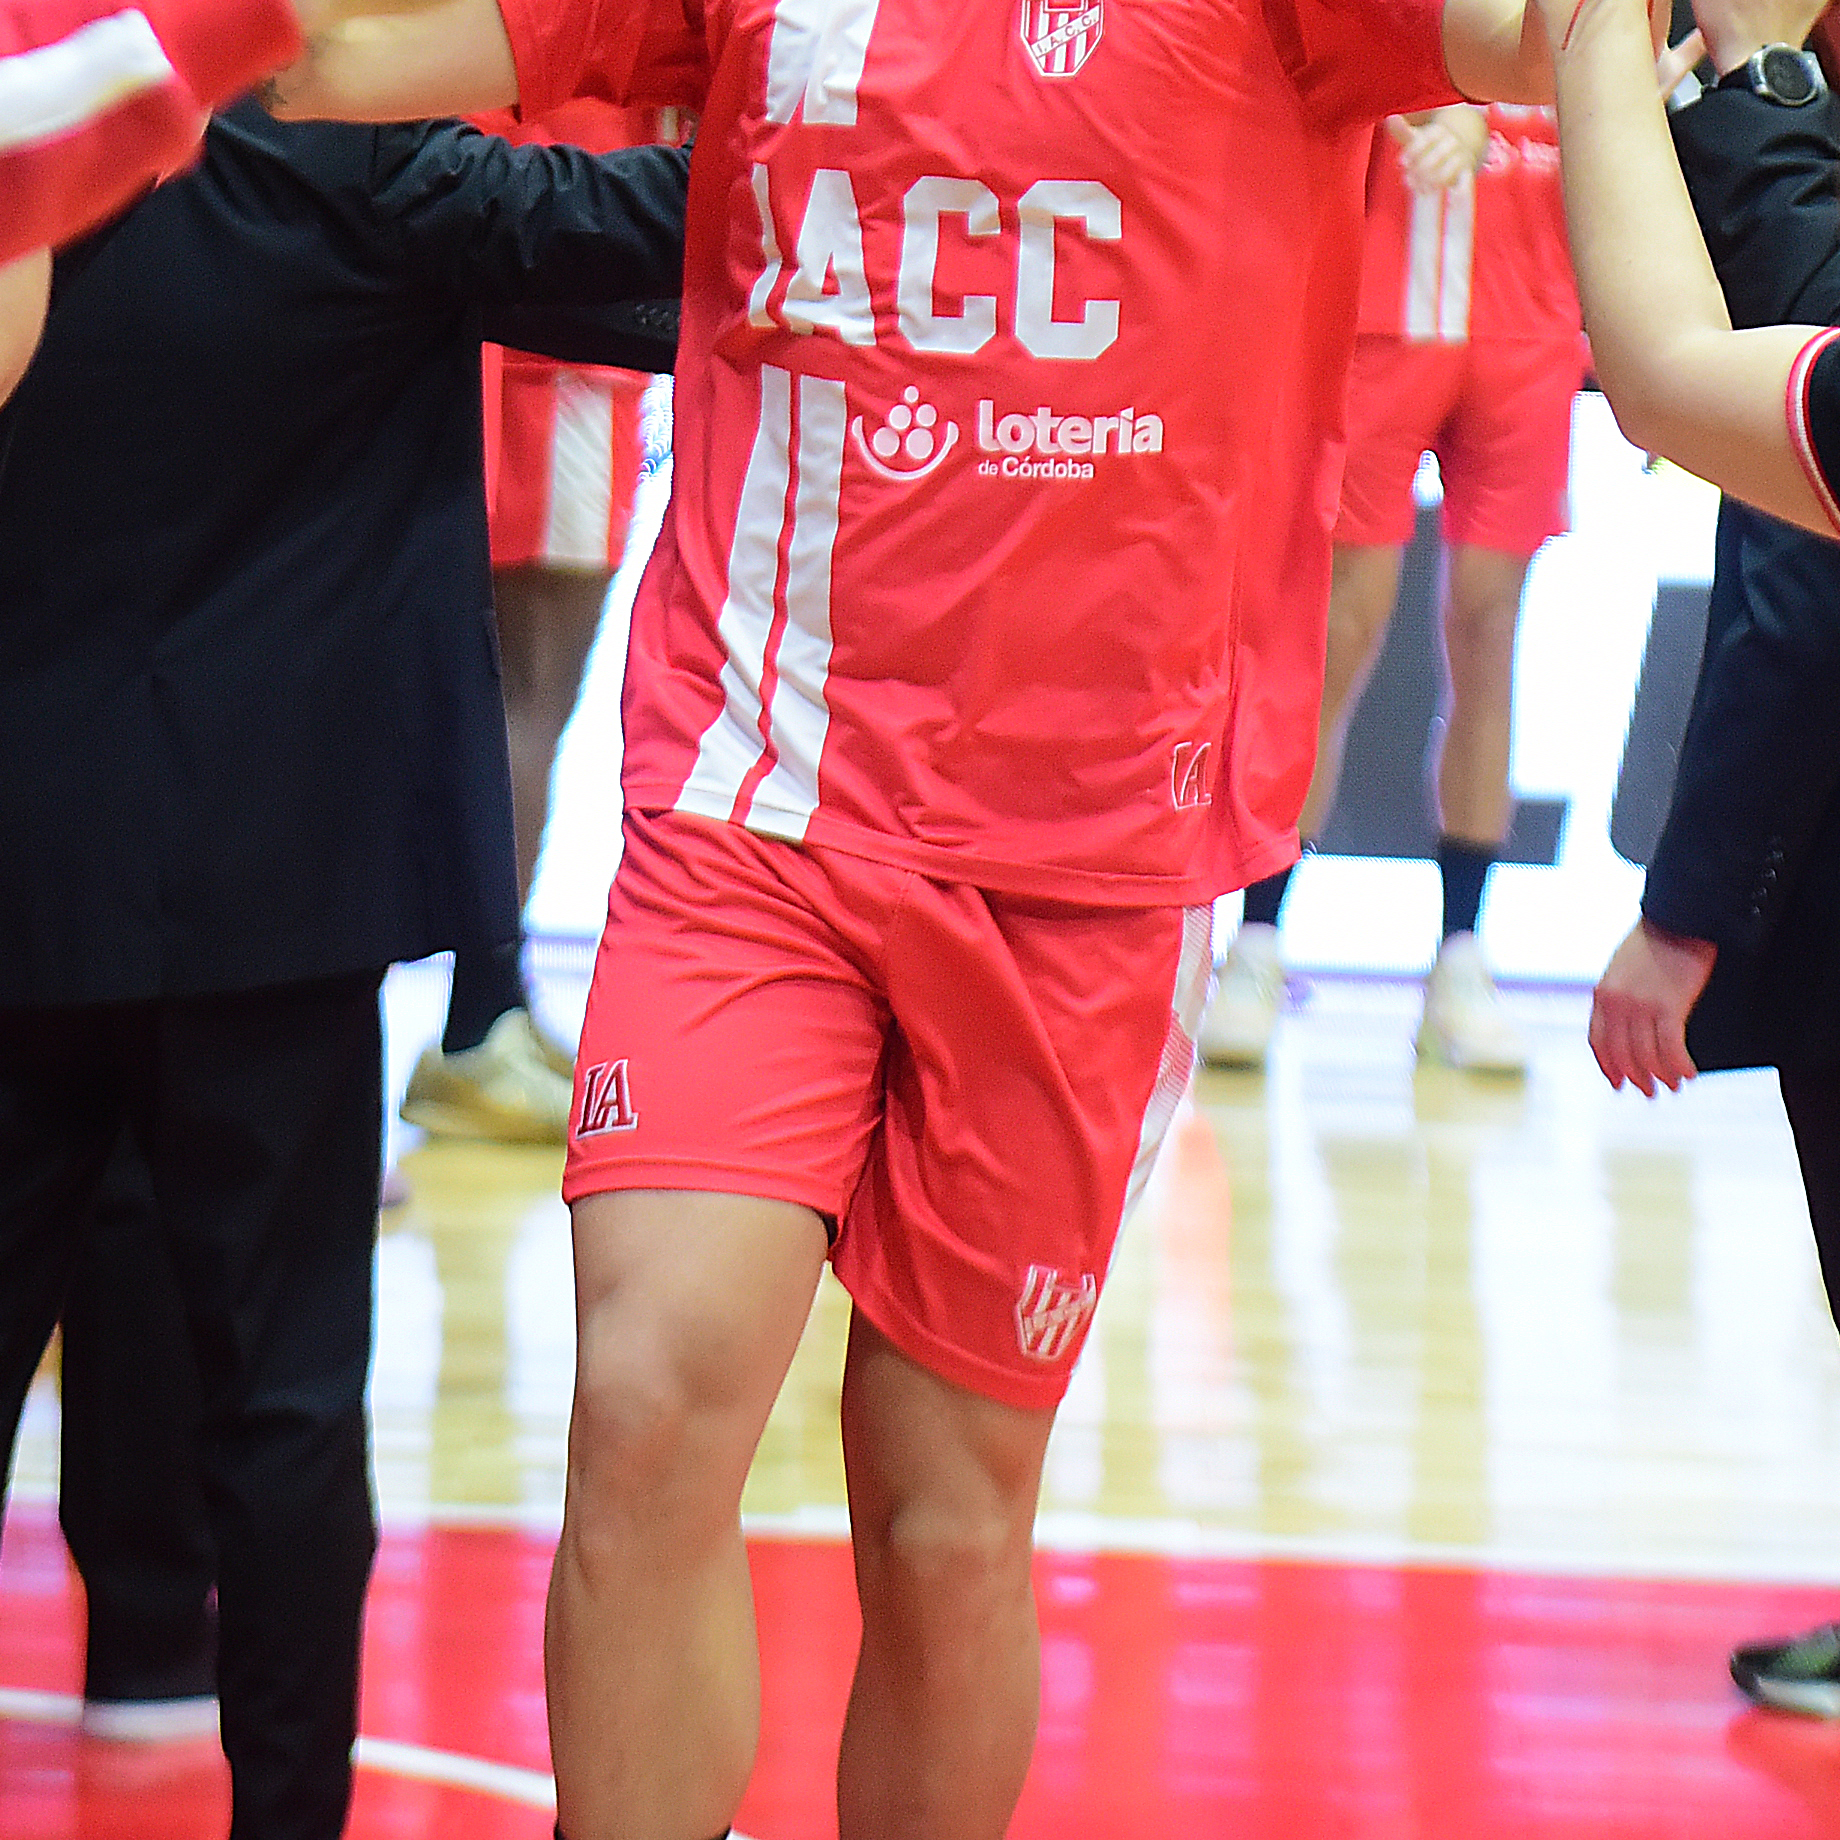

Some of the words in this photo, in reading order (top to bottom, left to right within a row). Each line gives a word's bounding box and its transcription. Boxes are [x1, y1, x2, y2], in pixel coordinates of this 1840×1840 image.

[749, 163, 1123, 361] IACC
[978, 459, 999, 476] de
[1002, 455, 1095, 480] Córdoba
